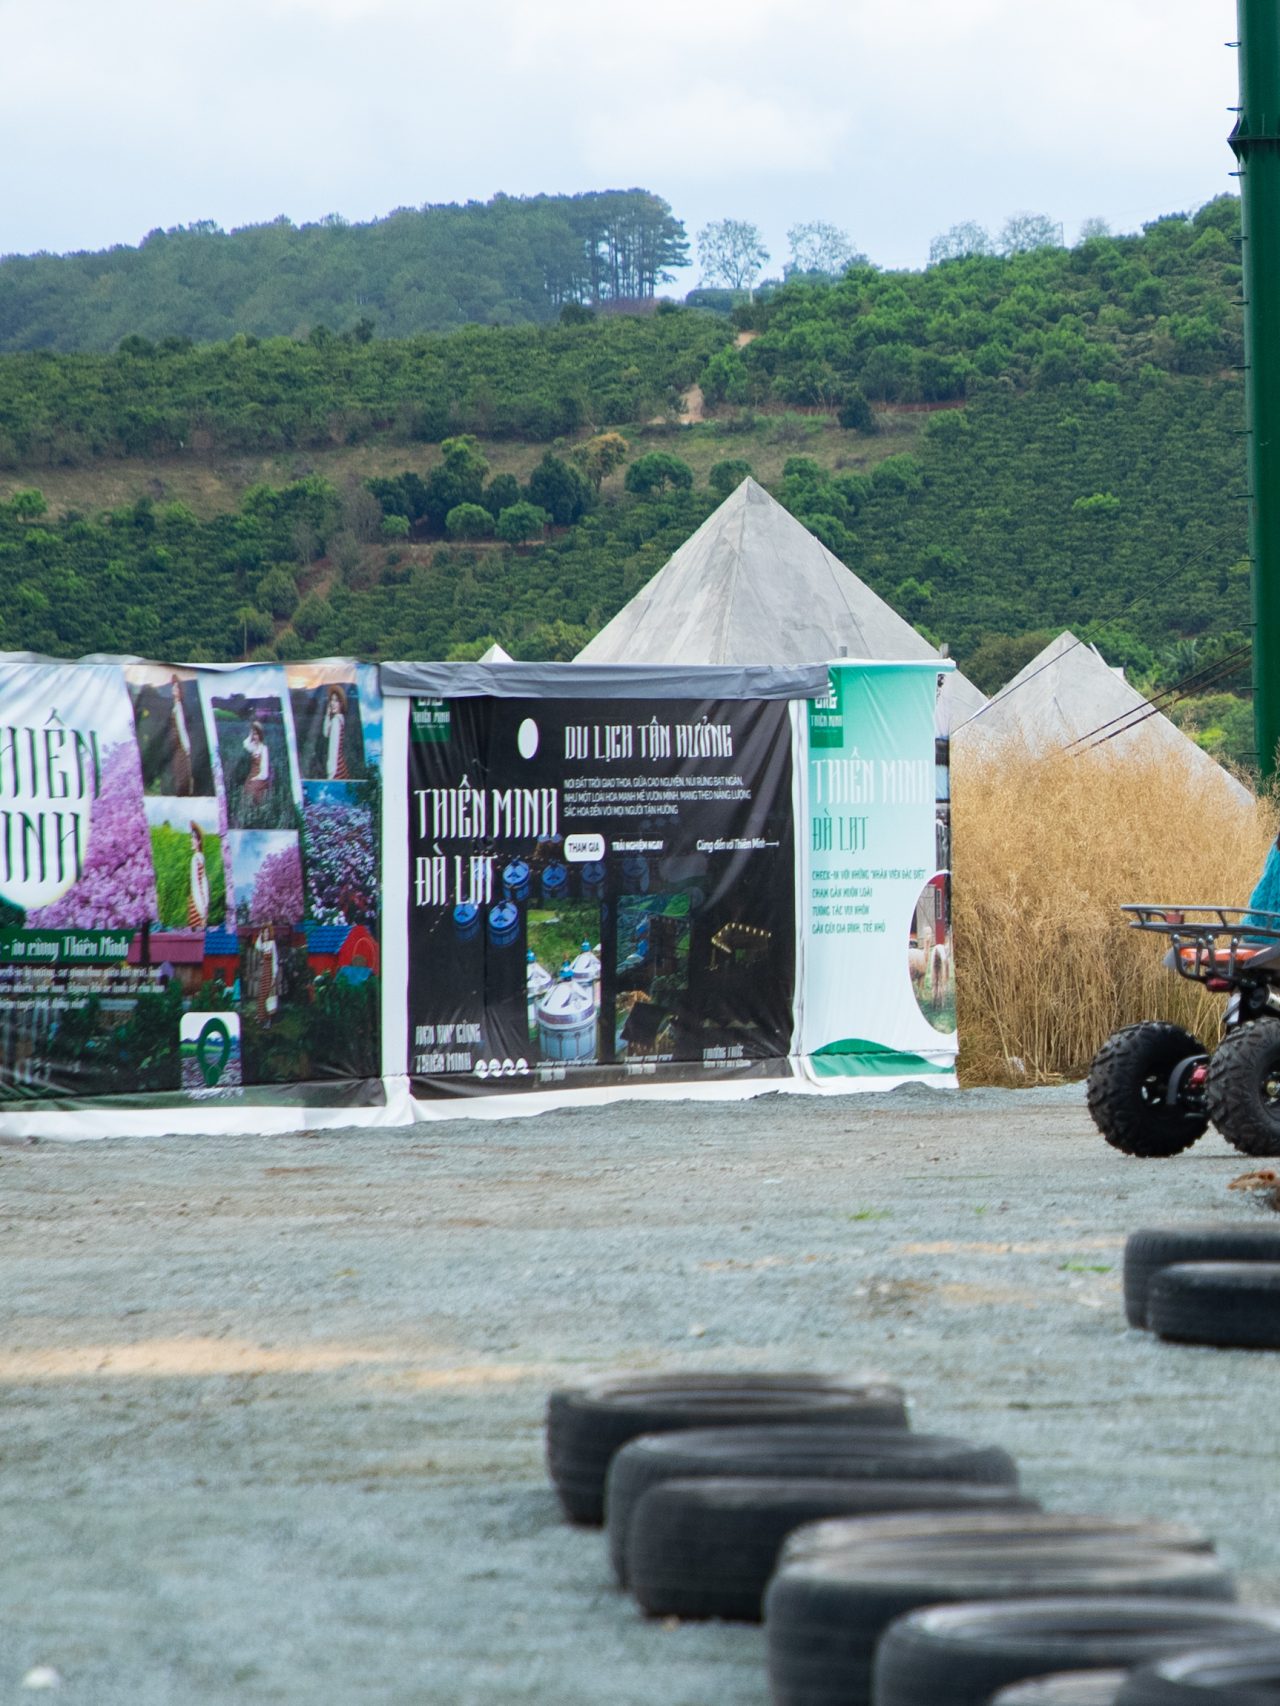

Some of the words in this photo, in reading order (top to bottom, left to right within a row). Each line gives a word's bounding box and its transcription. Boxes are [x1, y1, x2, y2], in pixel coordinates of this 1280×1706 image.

[565, 726, 588, 759] DU
[594, 725, 632, 762] LỊCH
[637, 715, 671, 762] TẬN
[675, 715, 733, 758] HƯỞNG
[811, 746, 874, 804] THIÊN
[881, 760, 929, 804] MINH
[414, 774, 485, 838] THIÊN
[492, 788, 557, 838] MINH
[568, 842, 587, 853] THAM
[589, 842, 600, 853] GIA
[812, 808, 832, 851] ĐÀ
[839, 816, 869, 855] LẠT
[414, 842, 447, 906] ĐÀ
[454, 855, 498, 909] LẠT
[62, 935, 98, 957] Thiên
[99, 935, 130, 957] Minh
